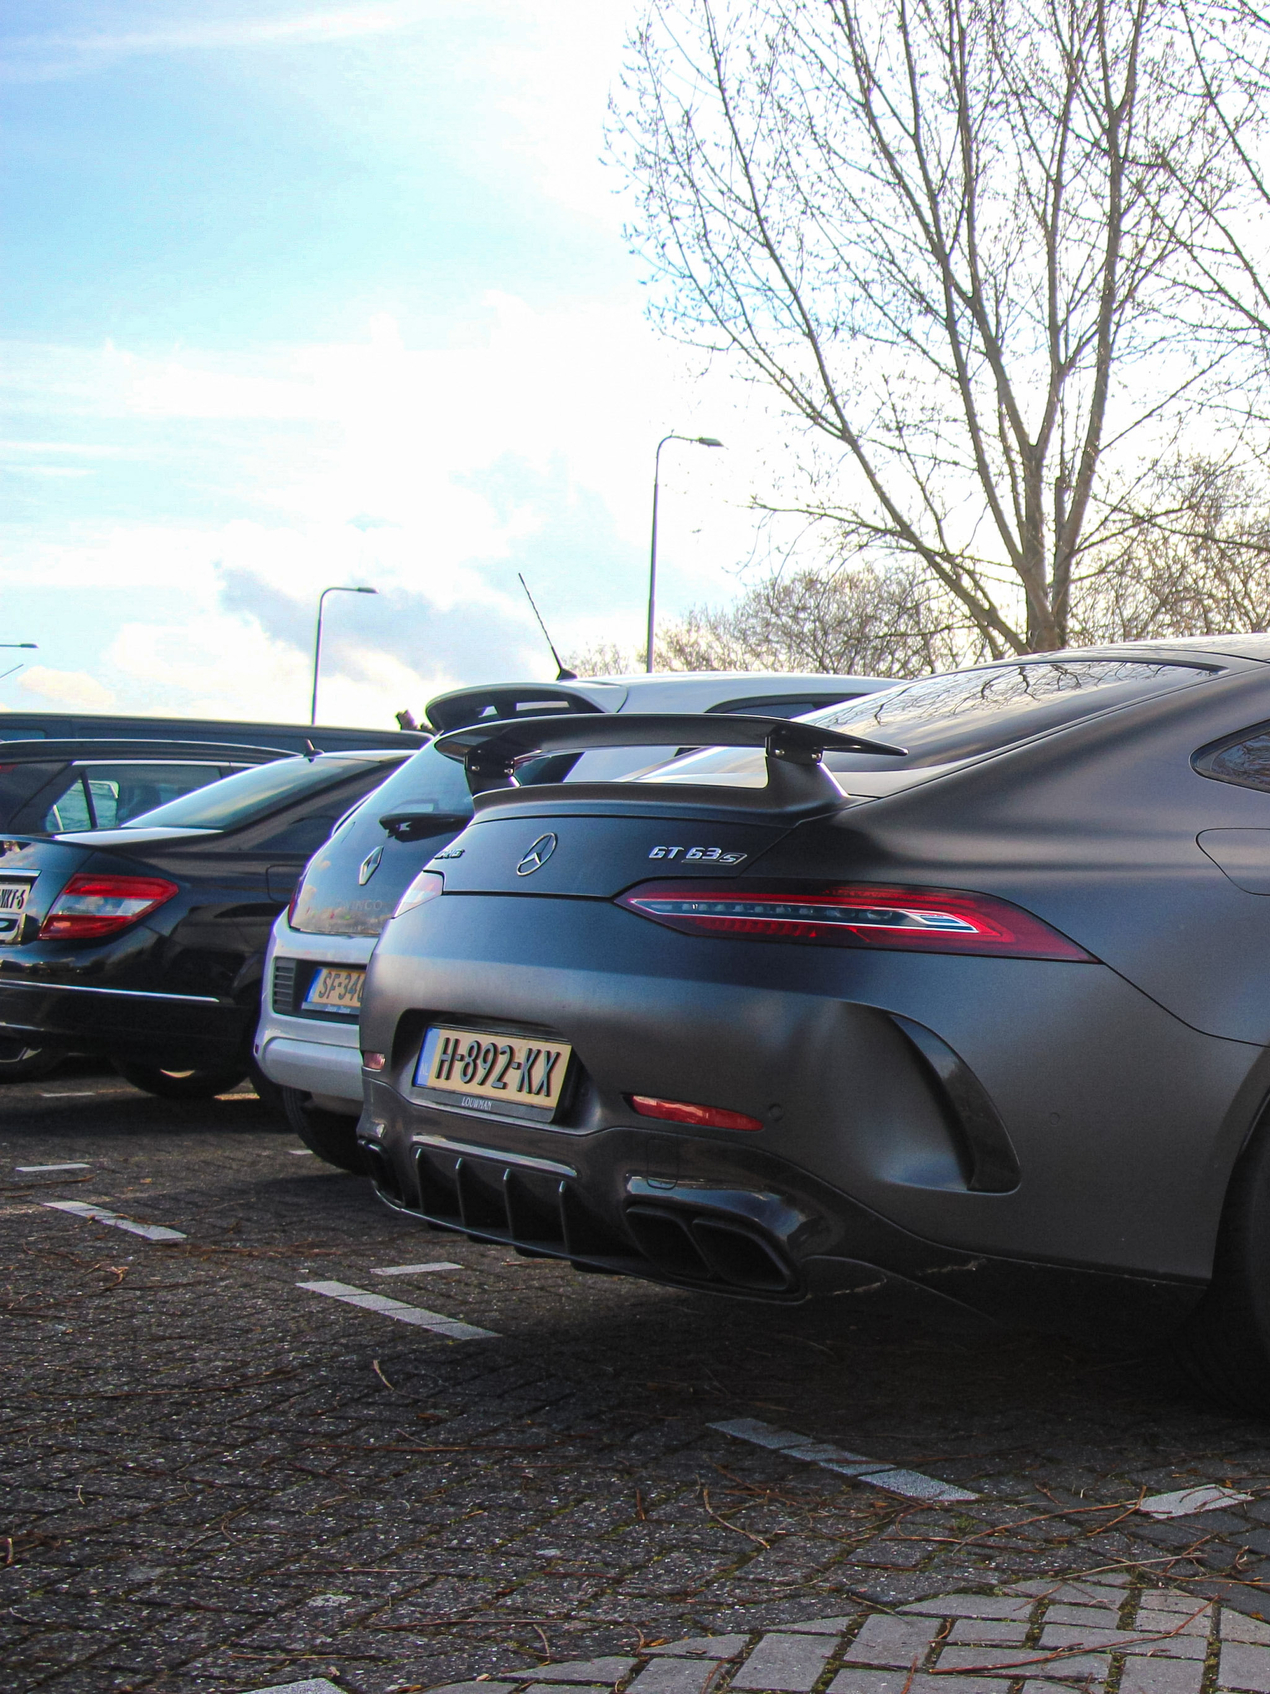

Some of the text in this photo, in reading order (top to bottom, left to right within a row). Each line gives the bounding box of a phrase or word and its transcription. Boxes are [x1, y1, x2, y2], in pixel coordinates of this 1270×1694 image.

[648, 846, 684, 860] GT
[435, 1037, 561, 1097] H-892-KX
[461, 1096, 492, 1111] LOUWMAN
